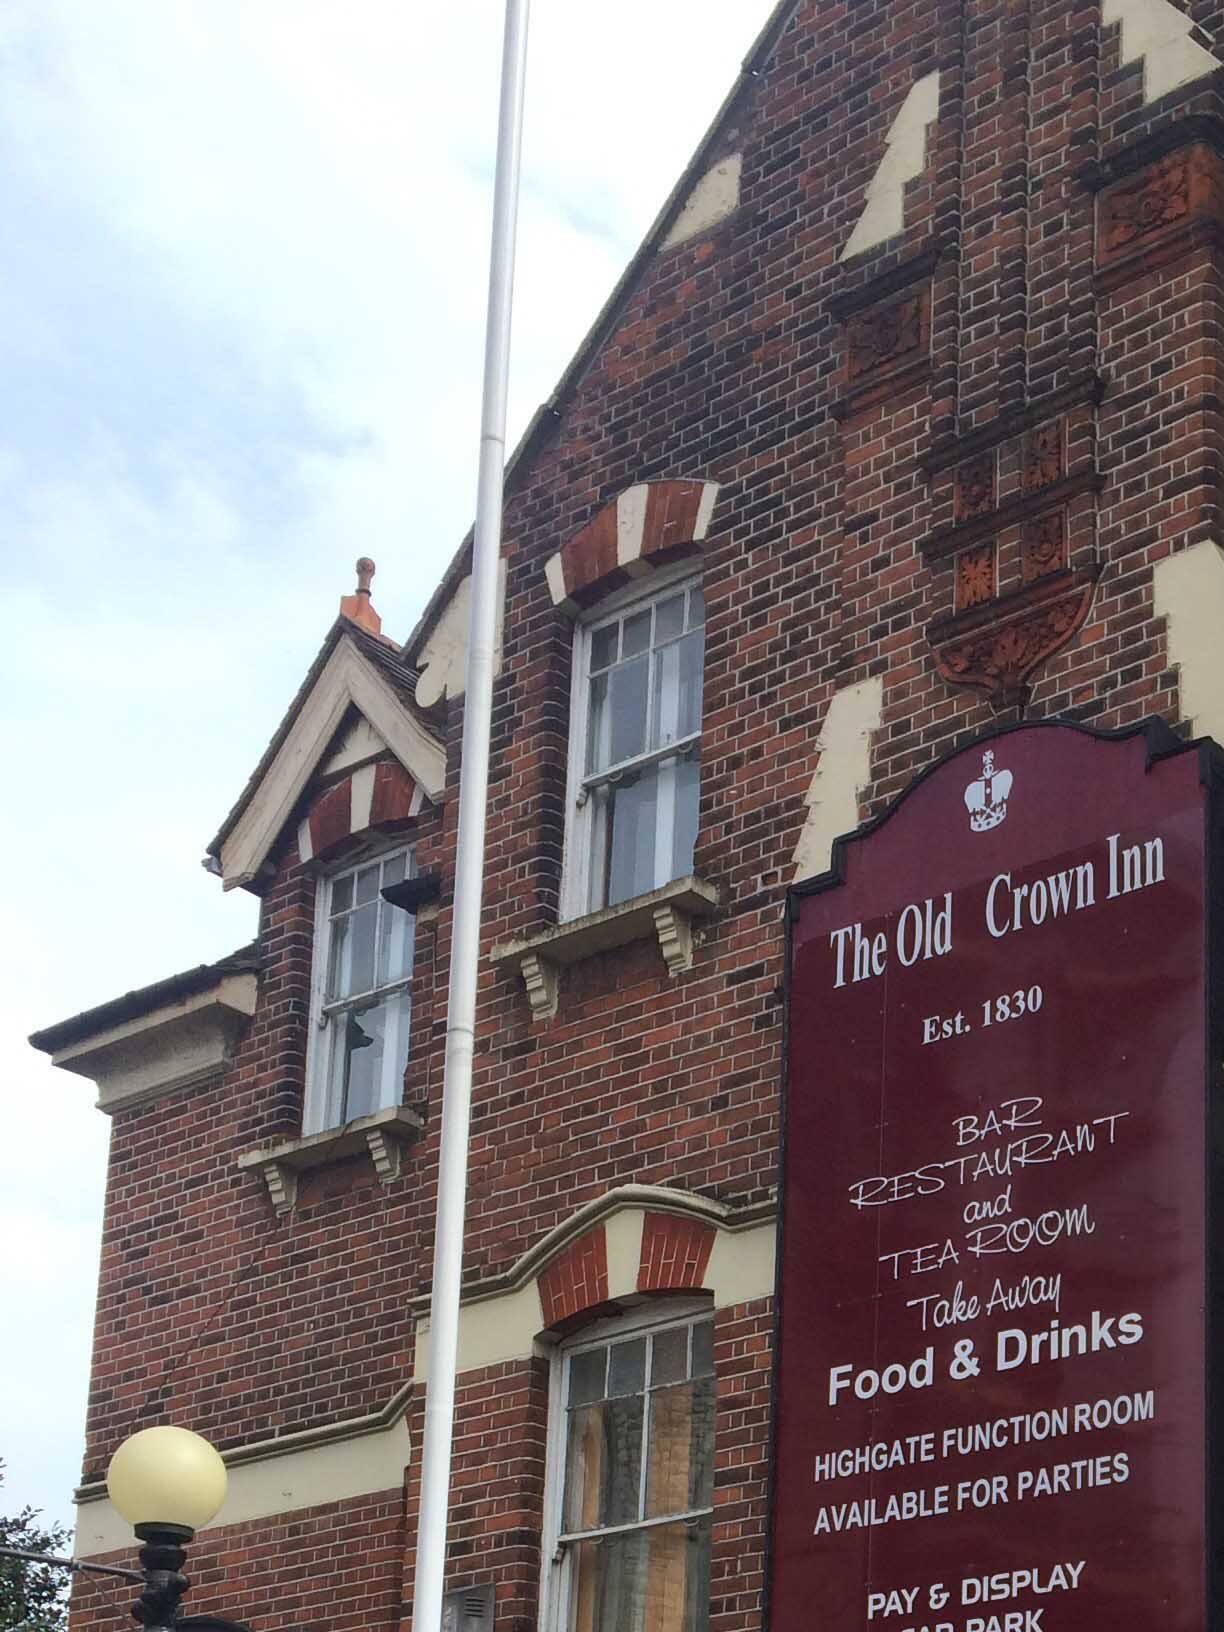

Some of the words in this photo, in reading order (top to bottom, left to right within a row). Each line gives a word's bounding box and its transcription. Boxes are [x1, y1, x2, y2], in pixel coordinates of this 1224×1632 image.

[830, 922, 887, 989] The
[896, 892, 953, 967] Old
[985, 861, 1096, 938] Crown
[1106, 833, 1165, 899] Inn
[922, 1011, 971, 1045] Est.
[982, 985, 1043, 1027] 1830
[951, 1096, 1043, 1146] BAR
[848, 1111, 1130, 1210] RESTAURANT
[878, 1238, 960, 1280] TEA
[965, 1203, 1096, 1258] ROOM
[963, 1183, 1012, 1224] and
[906, 1280, 981, 1331] Take
[985, 1273, 1062, 1316] Away
[828, 1346, 934, 1406] Food
[949, 1338, 981, 1380] &
[996, 1310, 1144, 1371] Drinks
[814, 1432, 935, 1482] HIGHGATE
[942, 1406, 1068, 1458] FUNCTION
[1074, 1390, 1154, 1433] ROOM
[813, 1485, 949, 1535] AVAILABLE
[957, 1475, 1009, 1511] FOR
[1017, 1452, 1130, 1500] PARTIES
[867, 1586, 920, 1620] PAY
[929, 1583, 950, 1610] &
[961, 1560, 1086, 1605] DISPLAY
